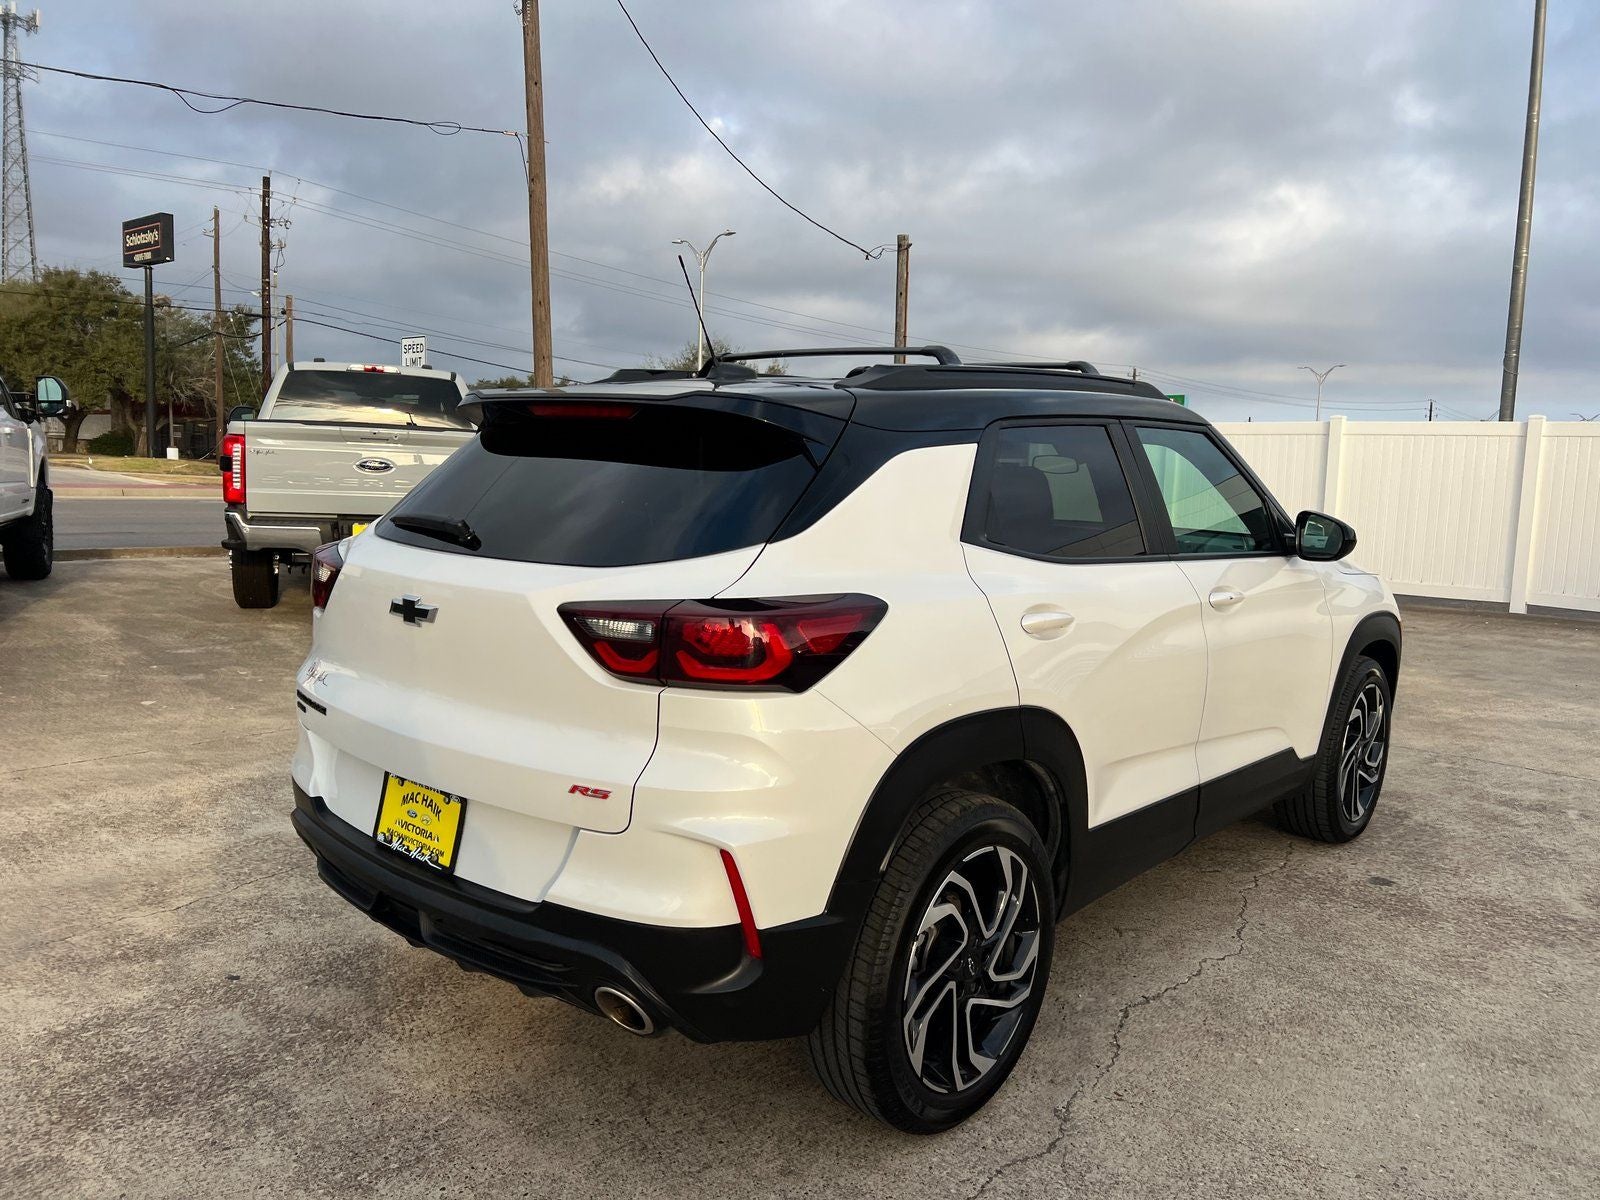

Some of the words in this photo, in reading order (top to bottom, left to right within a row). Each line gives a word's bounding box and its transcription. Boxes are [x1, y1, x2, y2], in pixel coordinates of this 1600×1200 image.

[403, 343, 424, 354] SPEED
[405, 356, 422, 367] LIMIT
[568, 784, 612, 800] RS
[401, 791, 421, 807] MAC
[421, 793, 442, 821] HAIK
[387, 836, 410, 855] Mac
[409, 847, 437, 866] Haik
